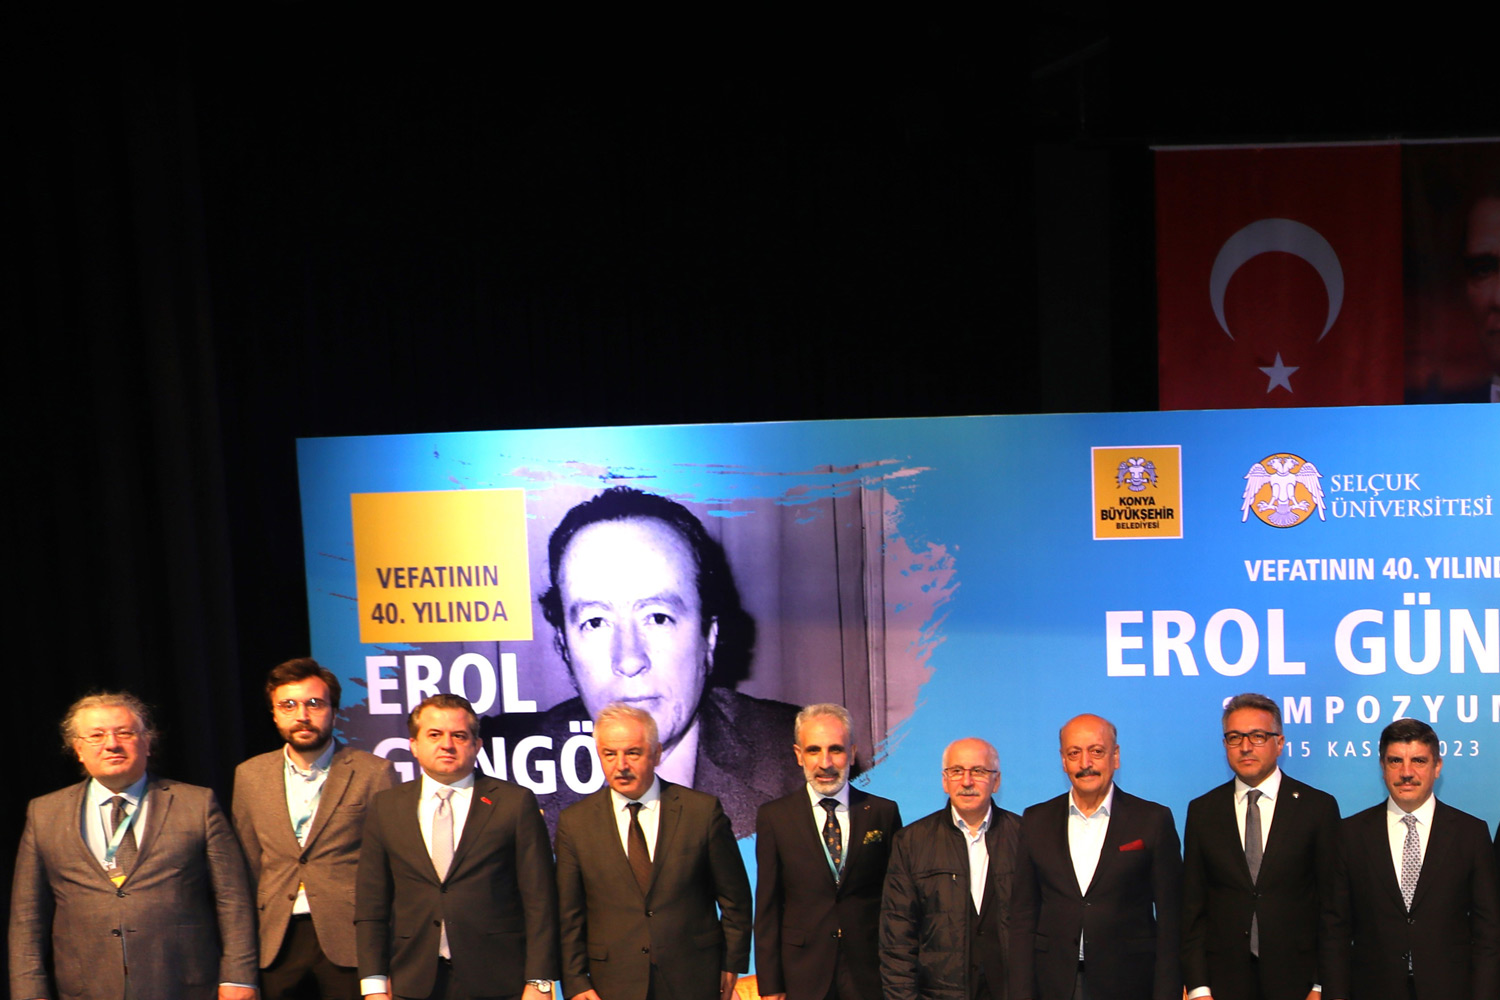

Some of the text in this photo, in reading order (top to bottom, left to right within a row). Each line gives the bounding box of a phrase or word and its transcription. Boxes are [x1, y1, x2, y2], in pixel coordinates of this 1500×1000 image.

[1330, 473, 1421, 497] SELÇUK
[1119, 496, 1156, 505] KONYA
[1331, 494, 1494, 519] ÜNİVERSİTESİ
[1100, 506, 1175, 521] BÜYÜKŞEHİR
[1116, 521, 1160, 529] BELEDİYESİ
[375, 565, 499, 589] VEFATININ
[1244, 557, 1375, 582] VEFATININ
[1383, 557, 1420, 580] 40.
[371, 600, 509, 625] 40. YILINDA
[1105, 608, 1306, 677] EROL
[364, 652, 537, 715] EROL
[1328, 740, 1380, 758] KAS
[1439, 740, 1480, 758] 023
